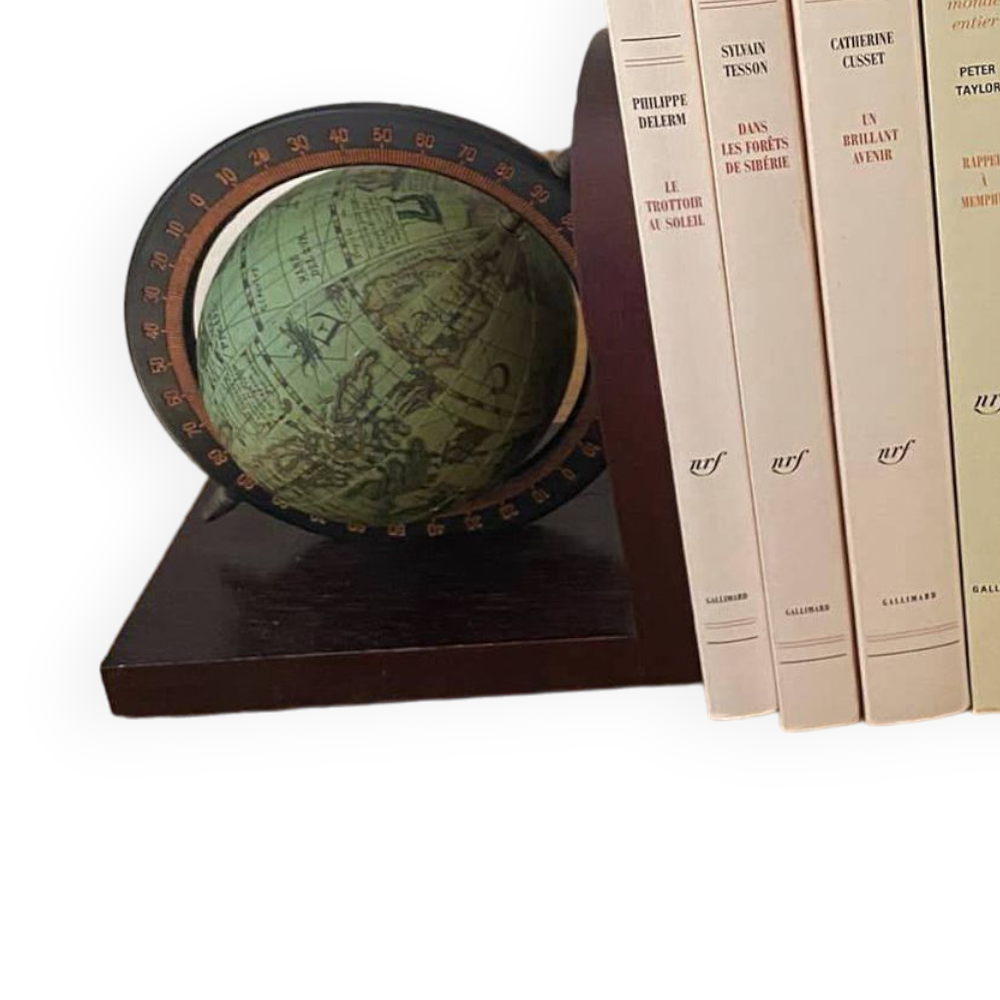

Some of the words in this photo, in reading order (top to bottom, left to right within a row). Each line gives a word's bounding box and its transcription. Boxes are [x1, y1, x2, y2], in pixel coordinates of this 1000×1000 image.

[952, 15, 1000, 31] entier
[830, 31, 894, 51] CATHERINE
[721, 41, 766, 59] SYLVAIN
[842, 52, 886, 69] CUSSET
[723, 62, 768, 78] TESSON
[959, 63, 996, 78] PETER
[955, 80, 1000, 97] TAYLOR
[632, 93, 688, 111] PHILIPPE
[638, 113, 687, 130] DELERM
[862, 112, 878, 126] UN
[329, 127, 349, 143] 40
[372, 127, 393, 143] 50
[738, 121, 768, 136] DANS
[286, 134, 310, 153] 30
[415, 132, 435, 149] 60
[721, 141, 742, 157] LES
[746, 135, 789, 154] FORÊTS
[843, 128, 899, 147] BRILLANT
[249, 148, 271, 166] 20
[457, 145, 478, 162] 70
[853, 148, 893, 165] AVENIR
[725, 161, 742, 175] DE
[745, 155, 790, 173] SIBÉRIE
[215, 166, 239, 187] 10
[665, 181, 679, 194] LE
[189, 192, 205, 208] 0
[645, 196, 703, 213] TROTTOIR
[165, 219, 185, 238] 10
[665, 214, 704, 230] SOLEIL
[150, 251, 169, 270] 20
[142, 322, 160, 341] 40
[149, 356, 167, 374] 50
[877, 439, 916, 466] nrf
[690, 451, 728, 477] nrf
[771, 449, 810, 475] nrf
[882, 591, 937, 607] GALLIMARD
[785, 604, 830, 617] GALLIMARD
